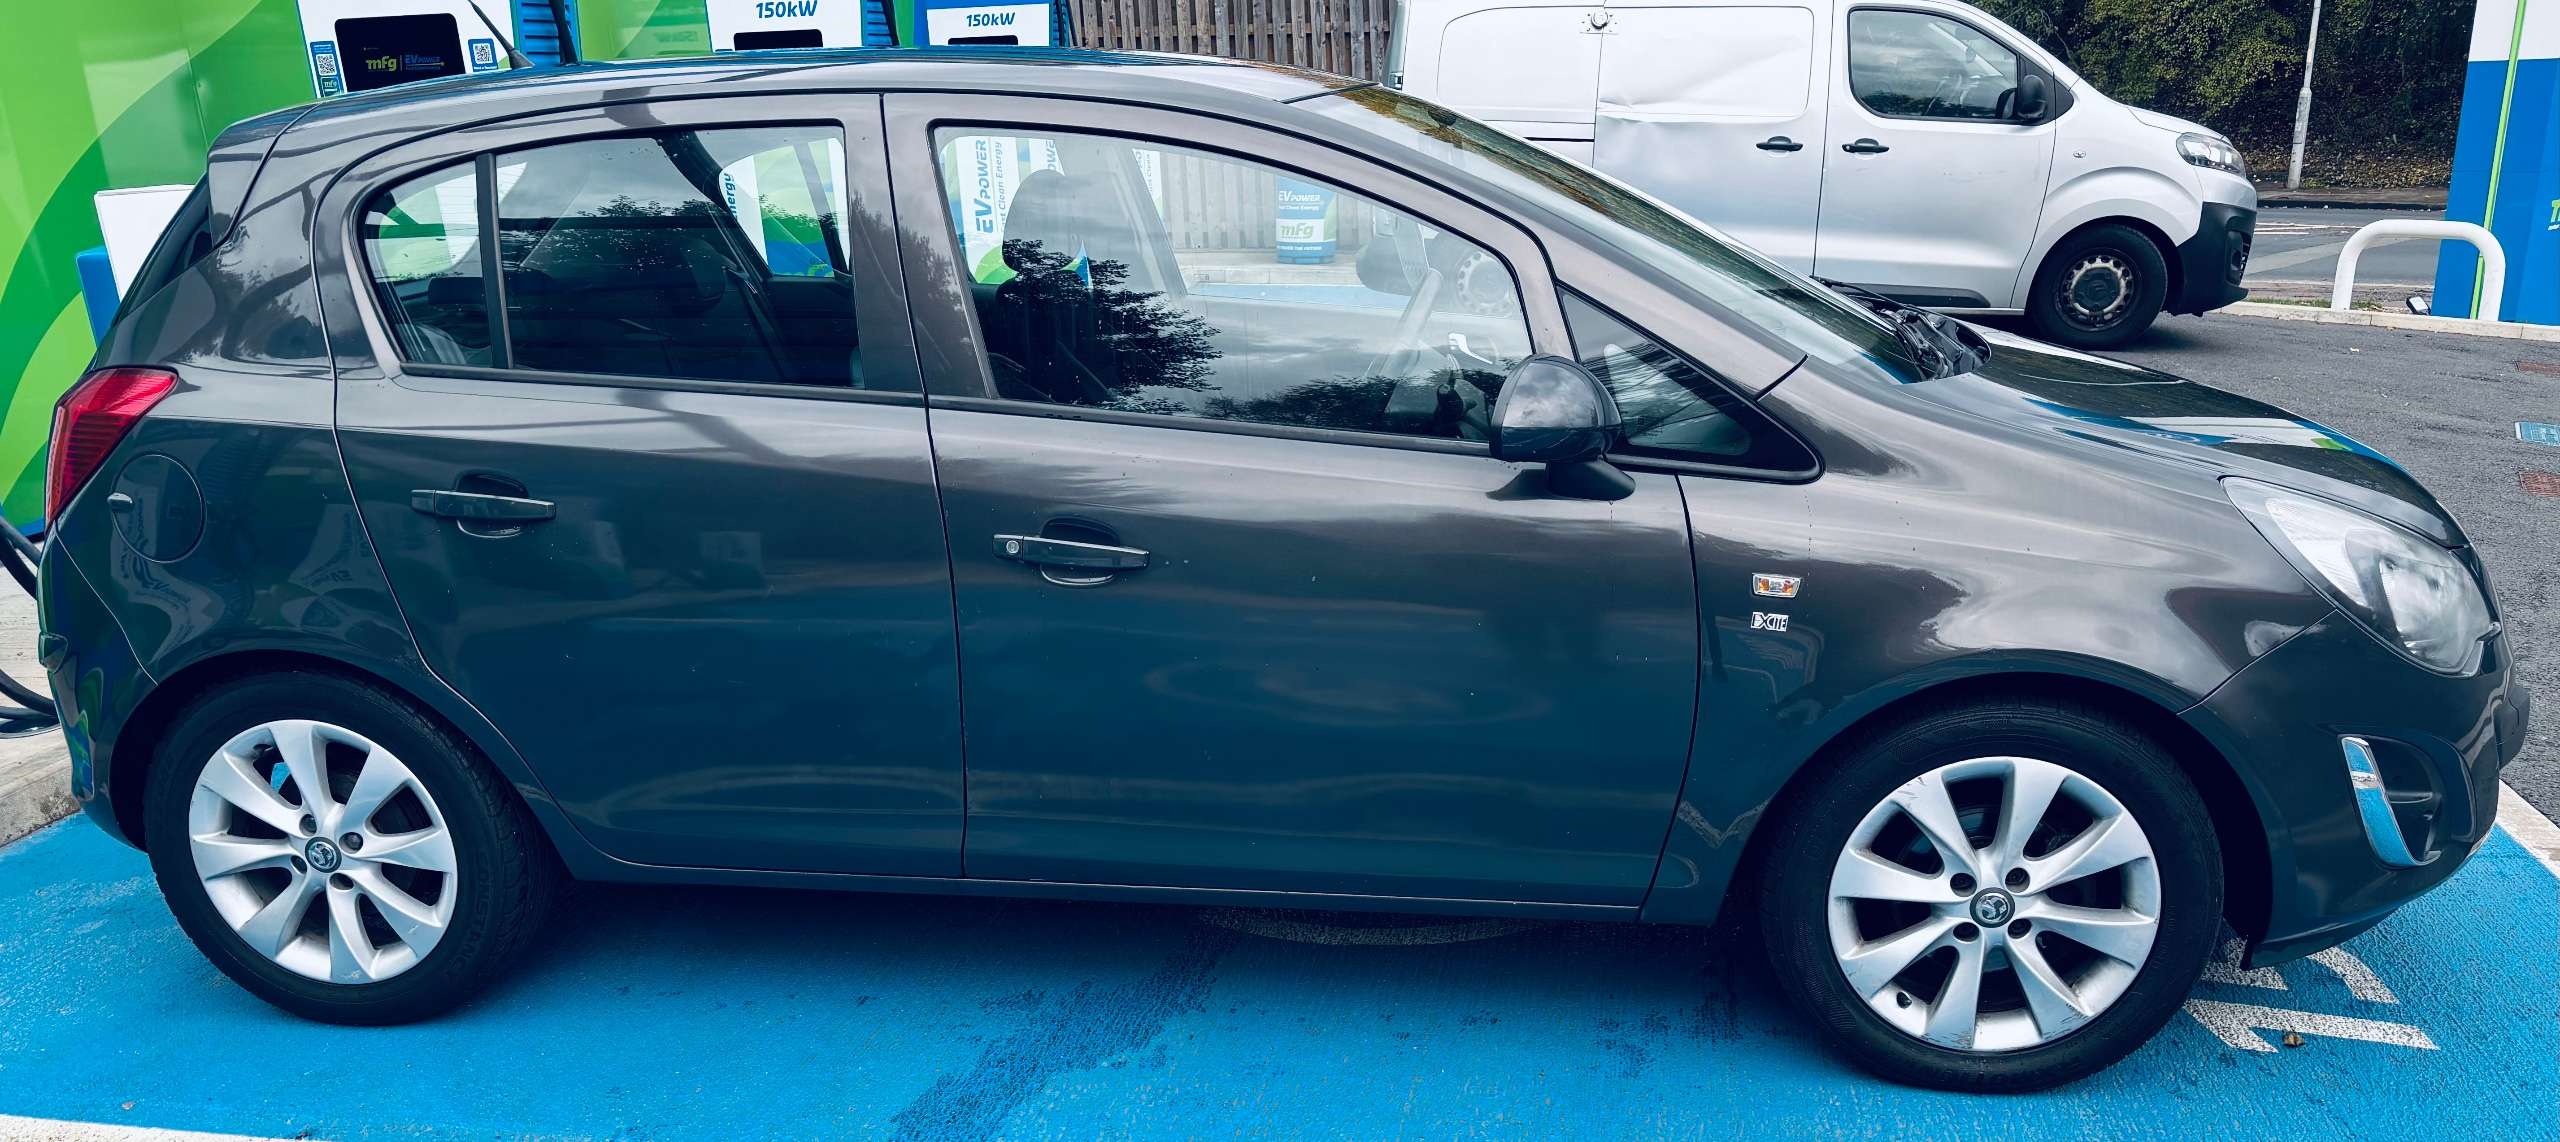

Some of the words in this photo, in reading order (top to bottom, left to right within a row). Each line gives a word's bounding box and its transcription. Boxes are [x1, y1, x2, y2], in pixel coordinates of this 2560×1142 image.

[756, 0, 818, 18] 150kW
[967, 12, 1015, 27] 150kW
[724, 173, 736, 216] nergy
[1751, 611, 1789, 632] EXCITE
